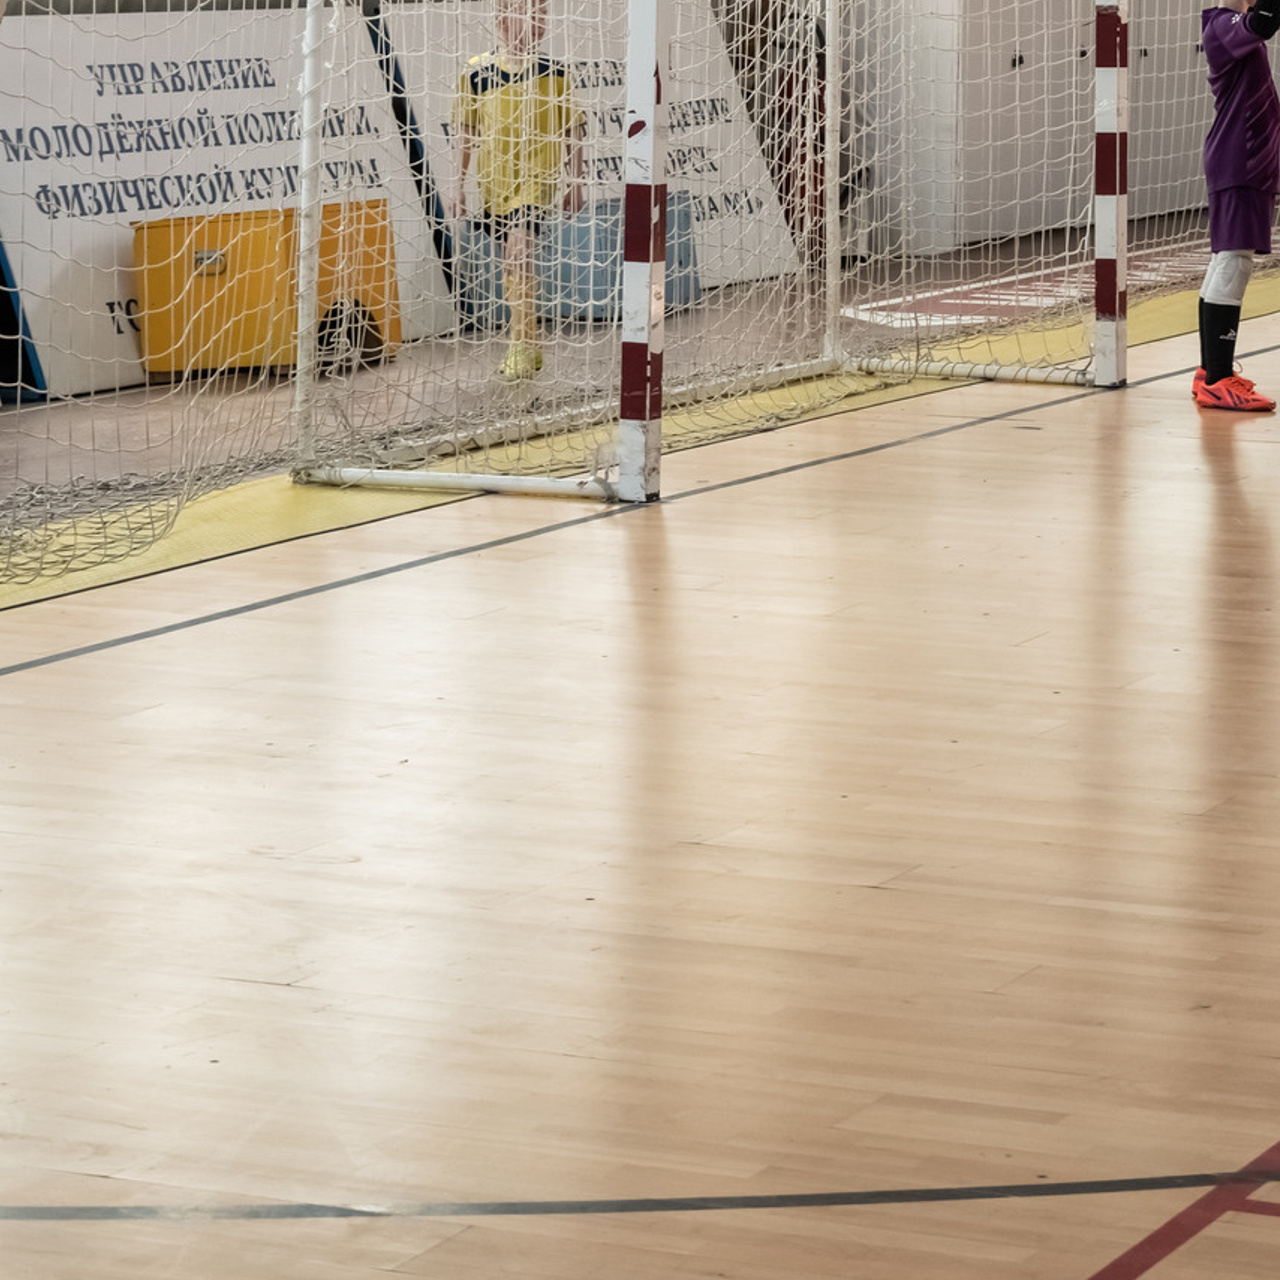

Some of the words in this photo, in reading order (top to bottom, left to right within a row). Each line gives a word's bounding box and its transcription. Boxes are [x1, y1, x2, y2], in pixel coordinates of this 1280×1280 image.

[86, 57, 276, 97] УПРАВЛЕНИЕ
[0, 108, 222, 163] МОЛОДЁЖНОЙ
[35, 164, 237, 220] ФИЗИЧЕСКОЙ
